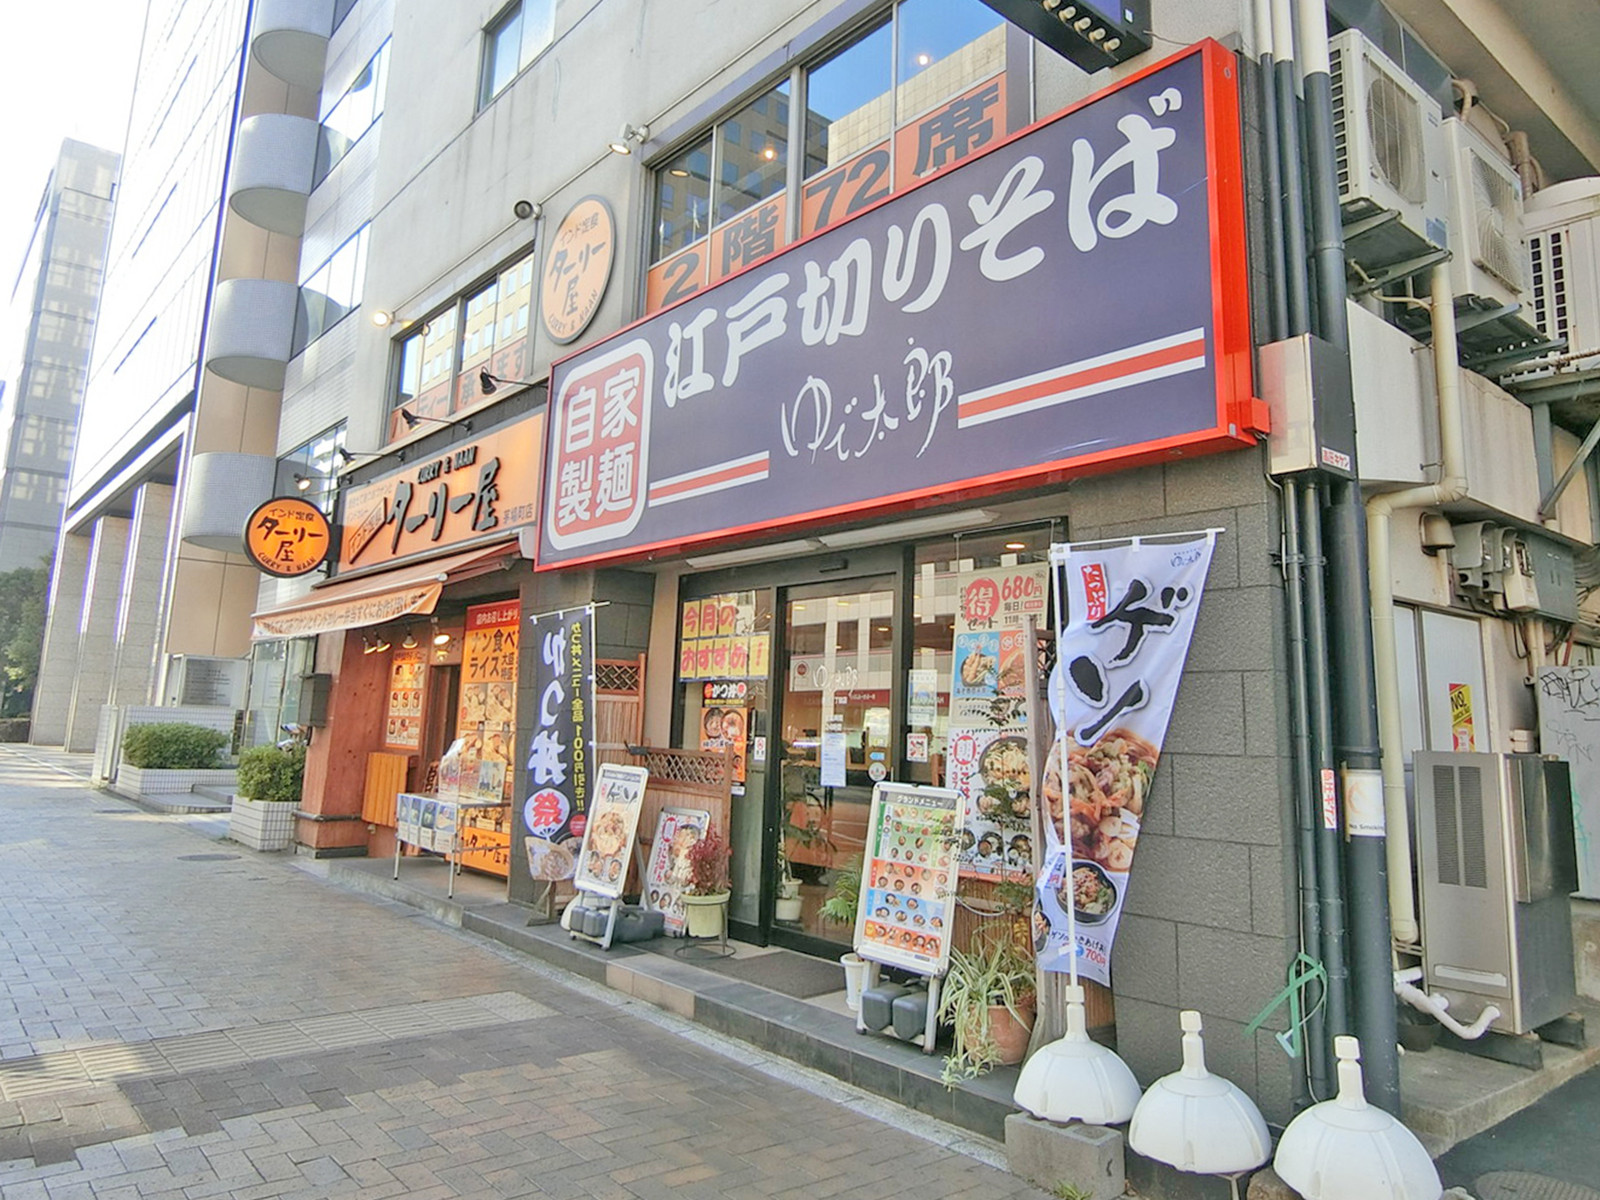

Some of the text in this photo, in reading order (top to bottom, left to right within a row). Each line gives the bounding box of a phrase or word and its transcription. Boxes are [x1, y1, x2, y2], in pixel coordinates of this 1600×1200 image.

[663, 87, 1179, 409] 江戸切りそば
[549, 241, 606, 294] ターリー
[560, 275, 579, 318] 屋
[565, 366, 643, 453] 自家
[781, 337, 955, 465] ゆで太郎
[559, 441, 634, 529] 製麺
[386, 456, 501, 555] ターリー屋
[257, 515, 324, 543] ターリー
[275, 541, 294, 562] 屋
[476, 608, 520, 625] 店内お召し上がり
[684, 603, 737, 632] 今月の
[968, 586, 993, 616] 得
[471, 628, 519, 653] ナン食べ
[470, 656, 499, 678] ライス
